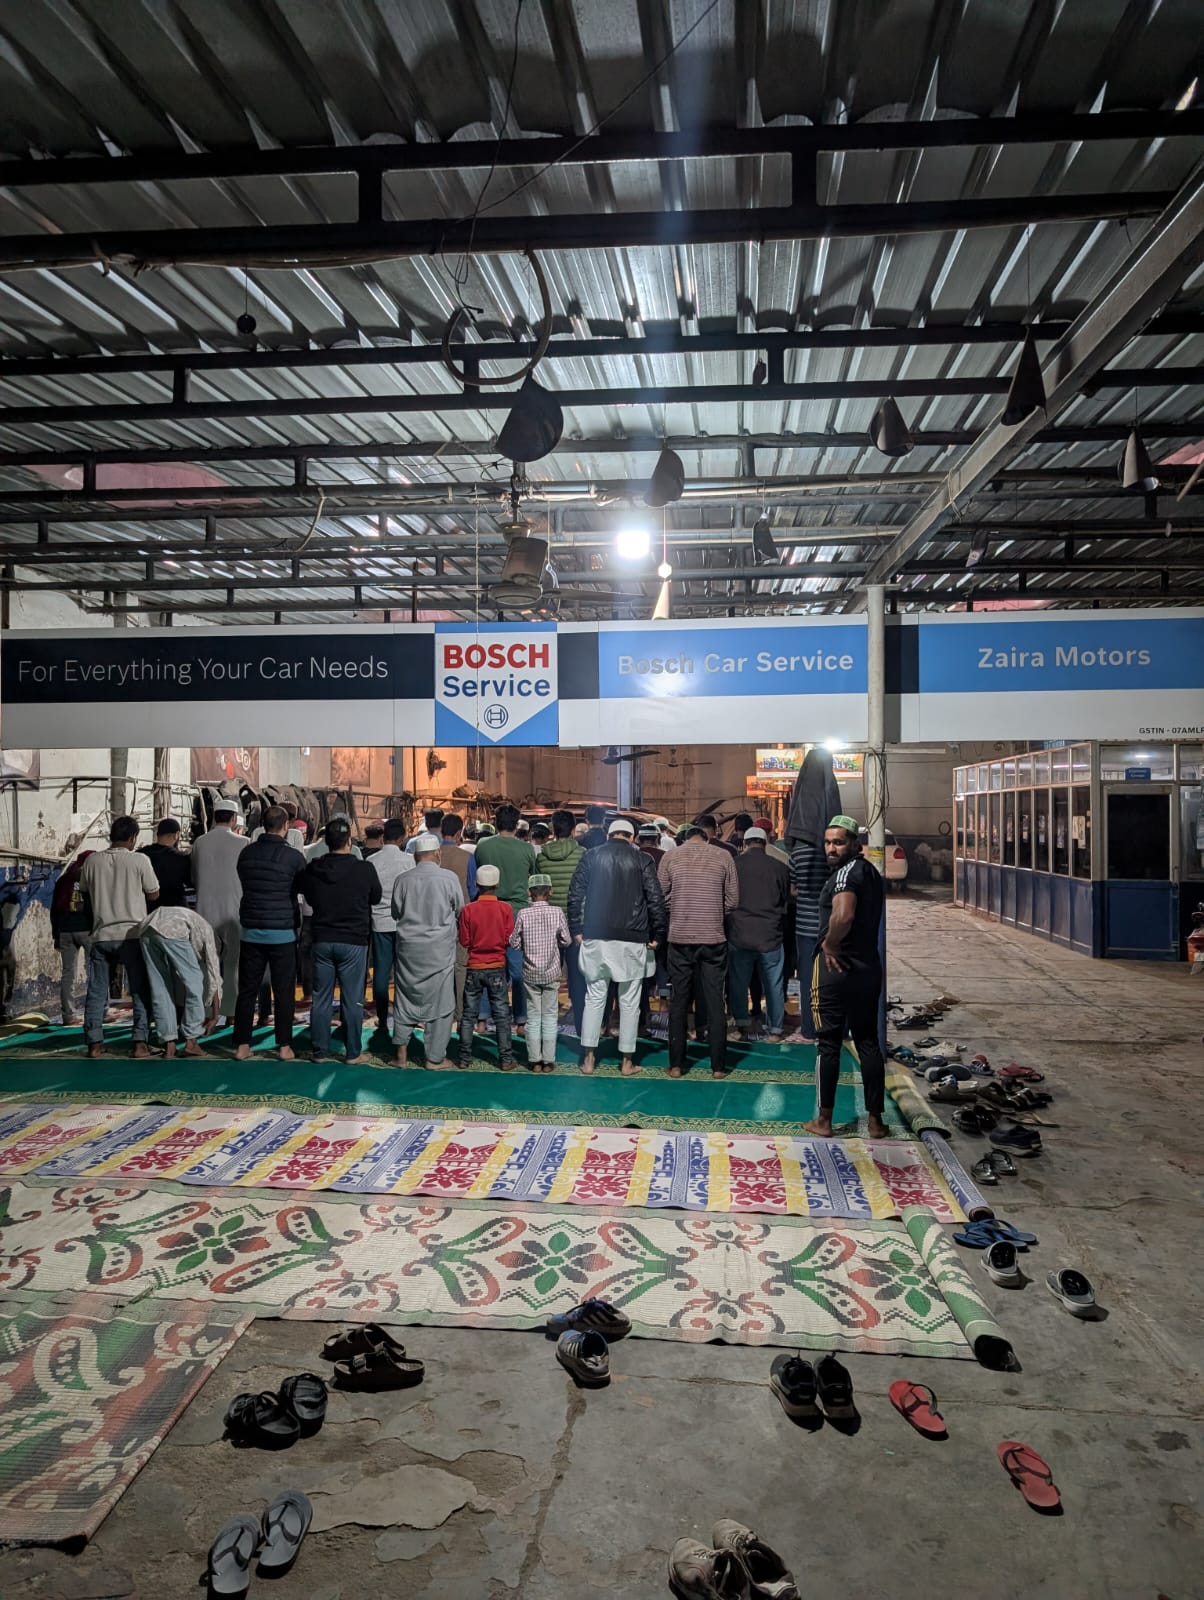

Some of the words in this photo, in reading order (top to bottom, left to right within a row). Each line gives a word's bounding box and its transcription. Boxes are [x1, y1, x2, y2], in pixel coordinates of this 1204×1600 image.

[443, 643, 549, 669] BOSCH
[618, 653, 694, 676] Bosch
[703, 653, 749, 673] Car
[756, 649, 854, 673] Service
[977, 646, 1045, 668] Zaira
[1054, 645, 1151, 667] Motors
[18, 660, 57, 683] For
[65, 658, 192, 686] Everything
[198, 658, 253, 680] Your
[259, 656, 303, 679] Car
[310, 655, 389, 679] Needs
[442, 673, 551, 697] Service
